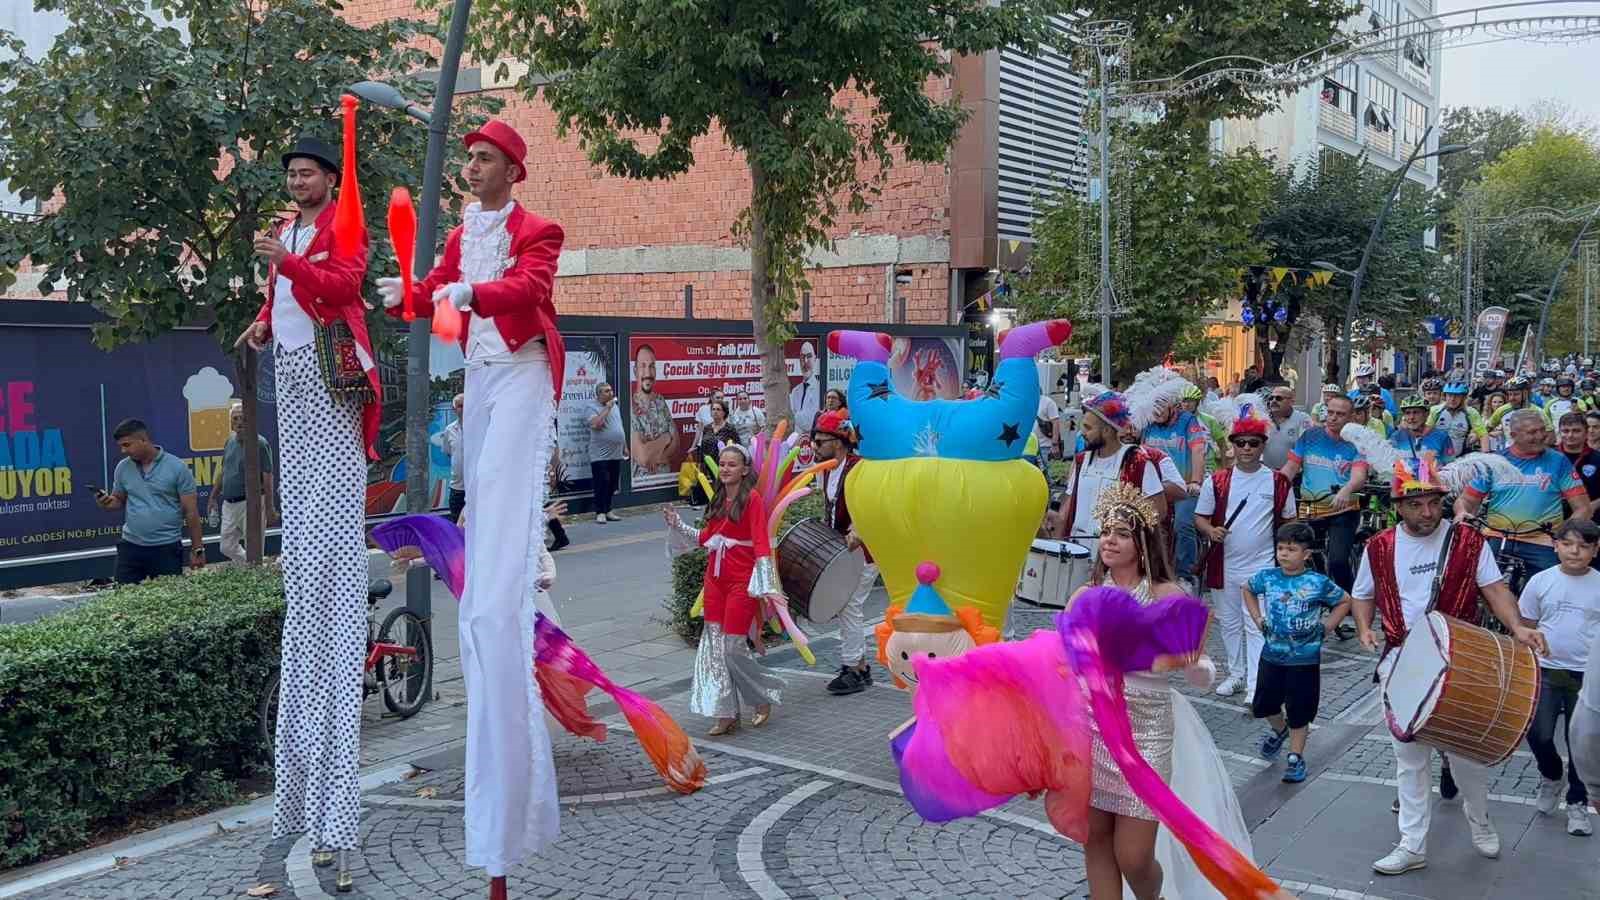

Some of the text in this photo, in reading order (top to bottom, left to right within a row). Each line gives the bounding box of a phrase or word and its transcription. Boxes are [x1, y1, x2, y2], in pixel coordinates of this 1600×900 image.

[687, 346, 704, 355] Uzm.
[706, 346, 716, 355] Dr.
[717, 343, 736, 356] Fatih
[663, 362, 694, 379] Çocuk
[696, 362, 730, 378] Sağlığı
[731, 365, 743, 375] ve
[0, 382, 35, 433] E
[22, 530, 65, 544] CADDESİ
